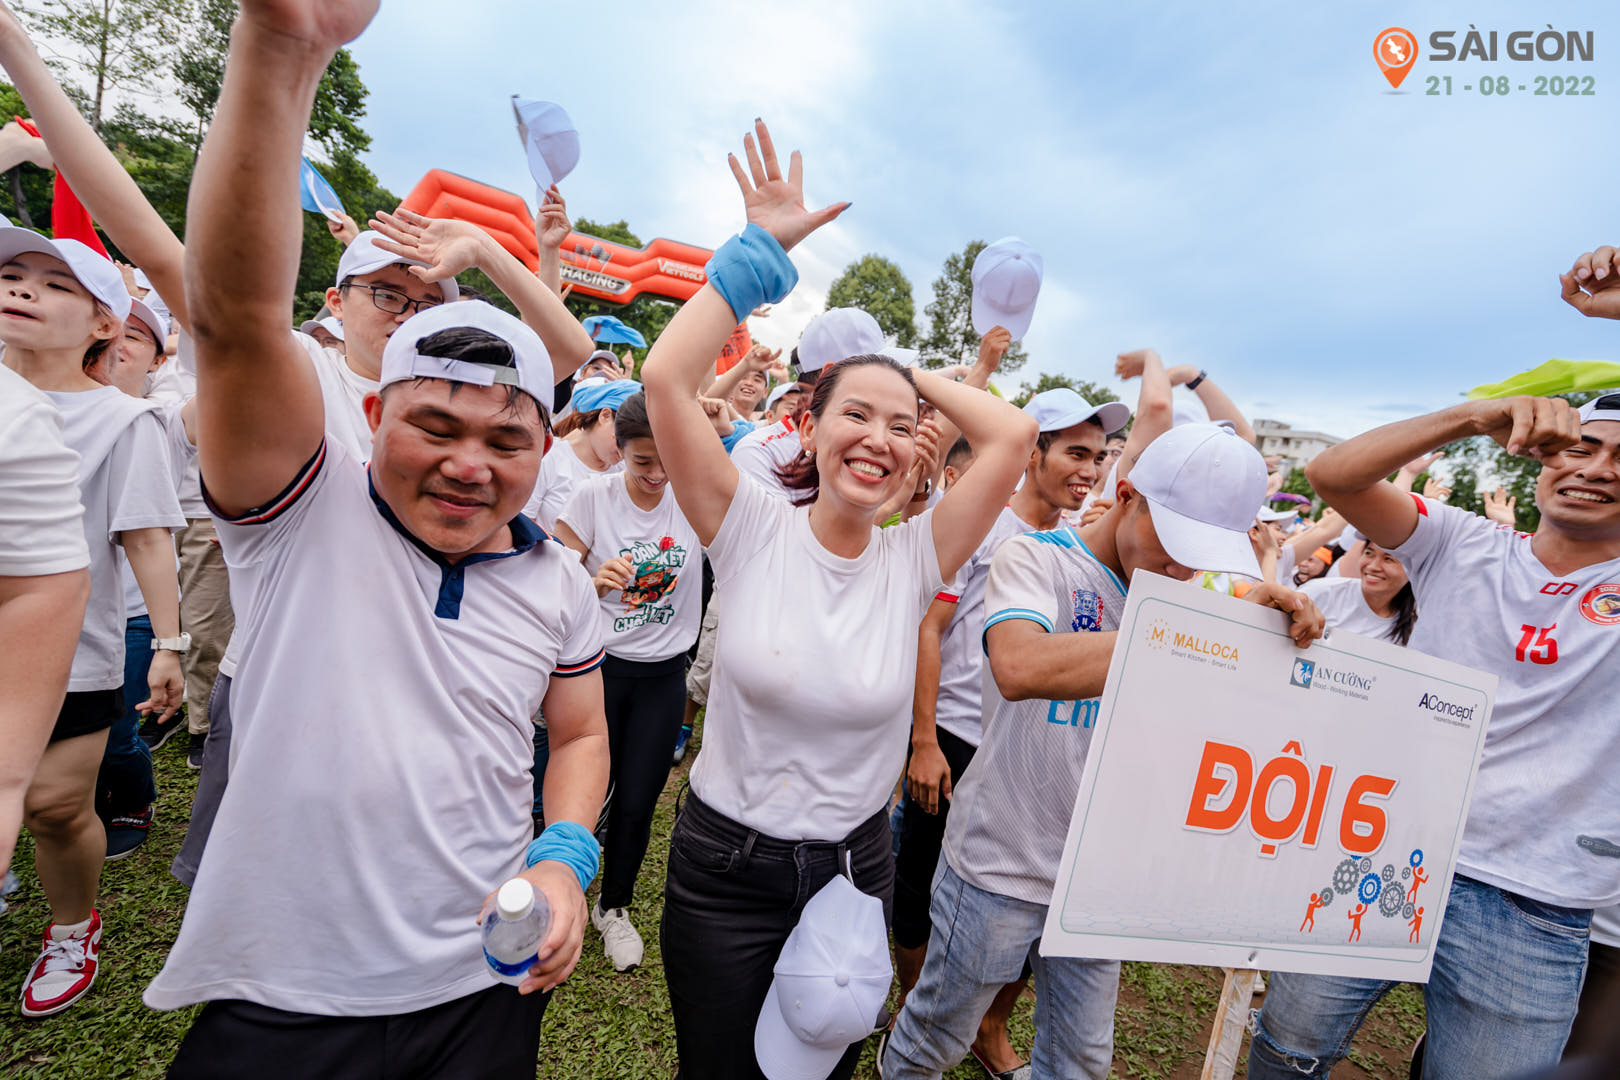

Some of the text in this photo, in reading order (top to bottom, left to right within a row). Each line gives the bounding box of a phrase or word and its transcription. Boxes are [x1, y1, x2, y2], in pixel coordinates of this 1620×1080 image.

[1173, 632, 1239, 662] MALLOCA
[1315, 667, 1333, 680] AN
[1183, 738, 1397, 857] ĐỘI 6
